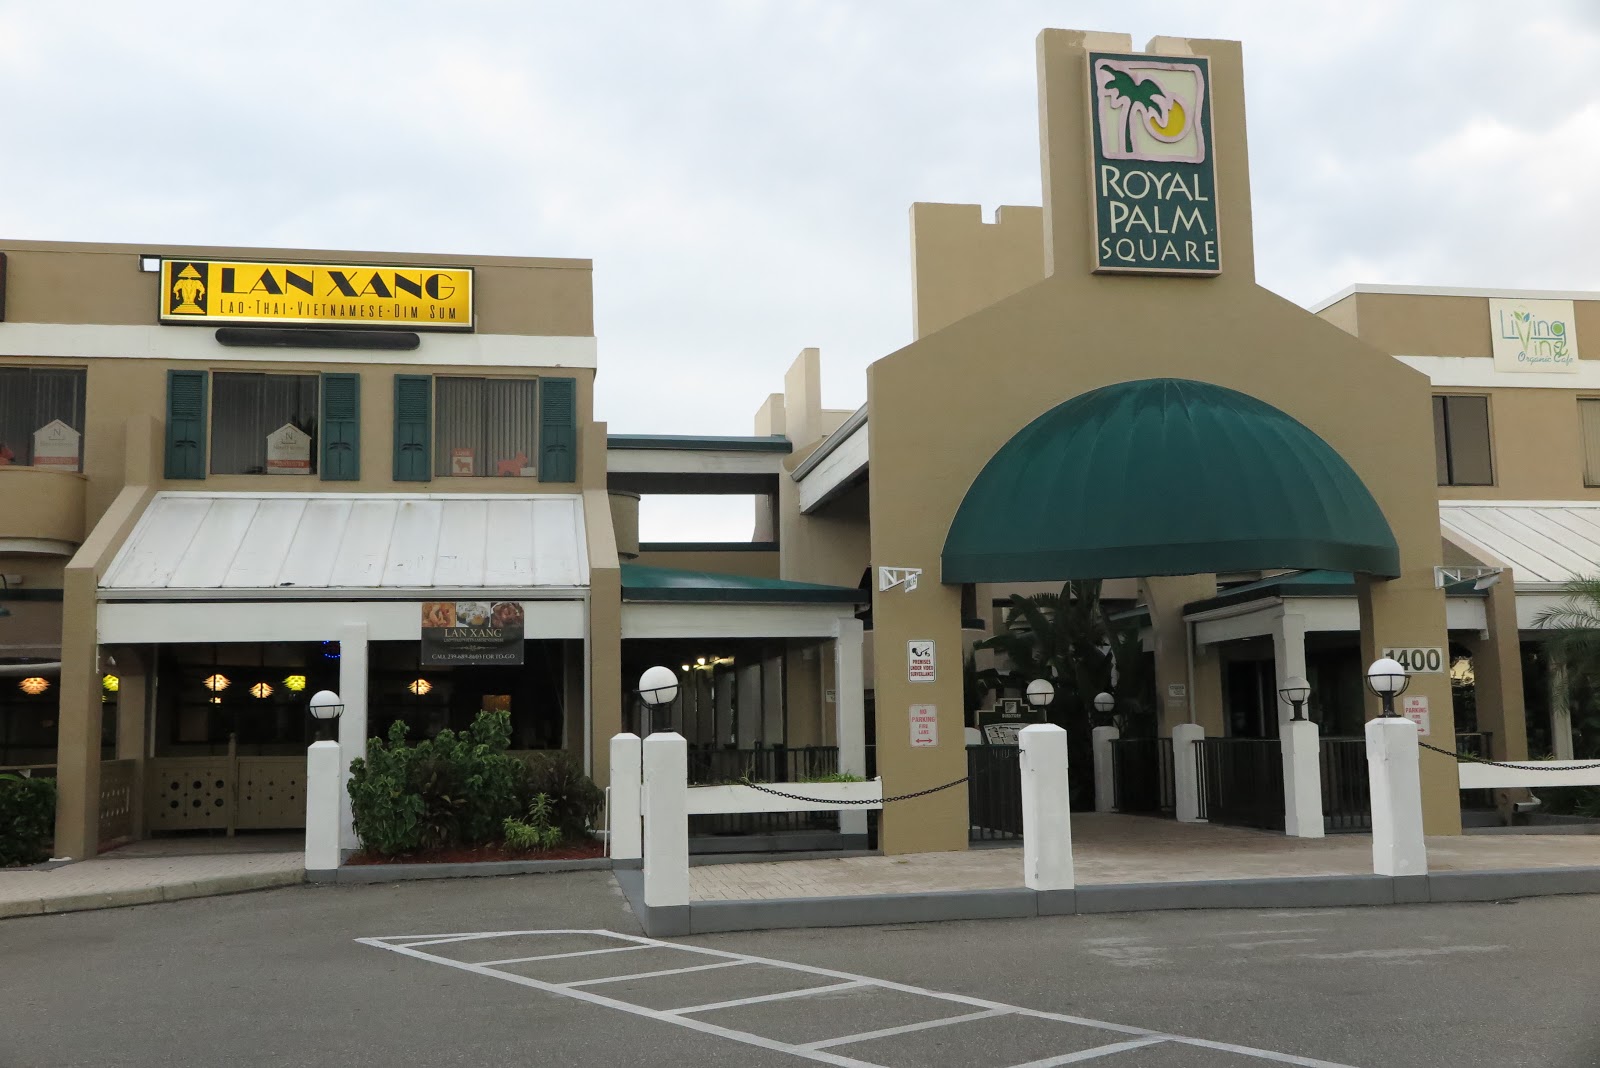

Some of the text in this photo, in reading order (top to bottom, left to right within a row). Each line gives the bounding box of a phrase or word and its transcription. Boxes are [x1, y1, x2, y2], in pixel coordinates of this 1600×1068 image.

[1101, 164, 1209, 201] ROYAL
[1109, 200, 1208, 235] PALM
[1101, 237, 1216, 263] SQUARE
[221, 267, 456, 300] LAN XANG
[430, 304, 456, 320] SUM
[1518, 351, 1552, 365] Organic
[286, 432, 293, 440] N
[444, 628, 502, 638] LAN XANG
